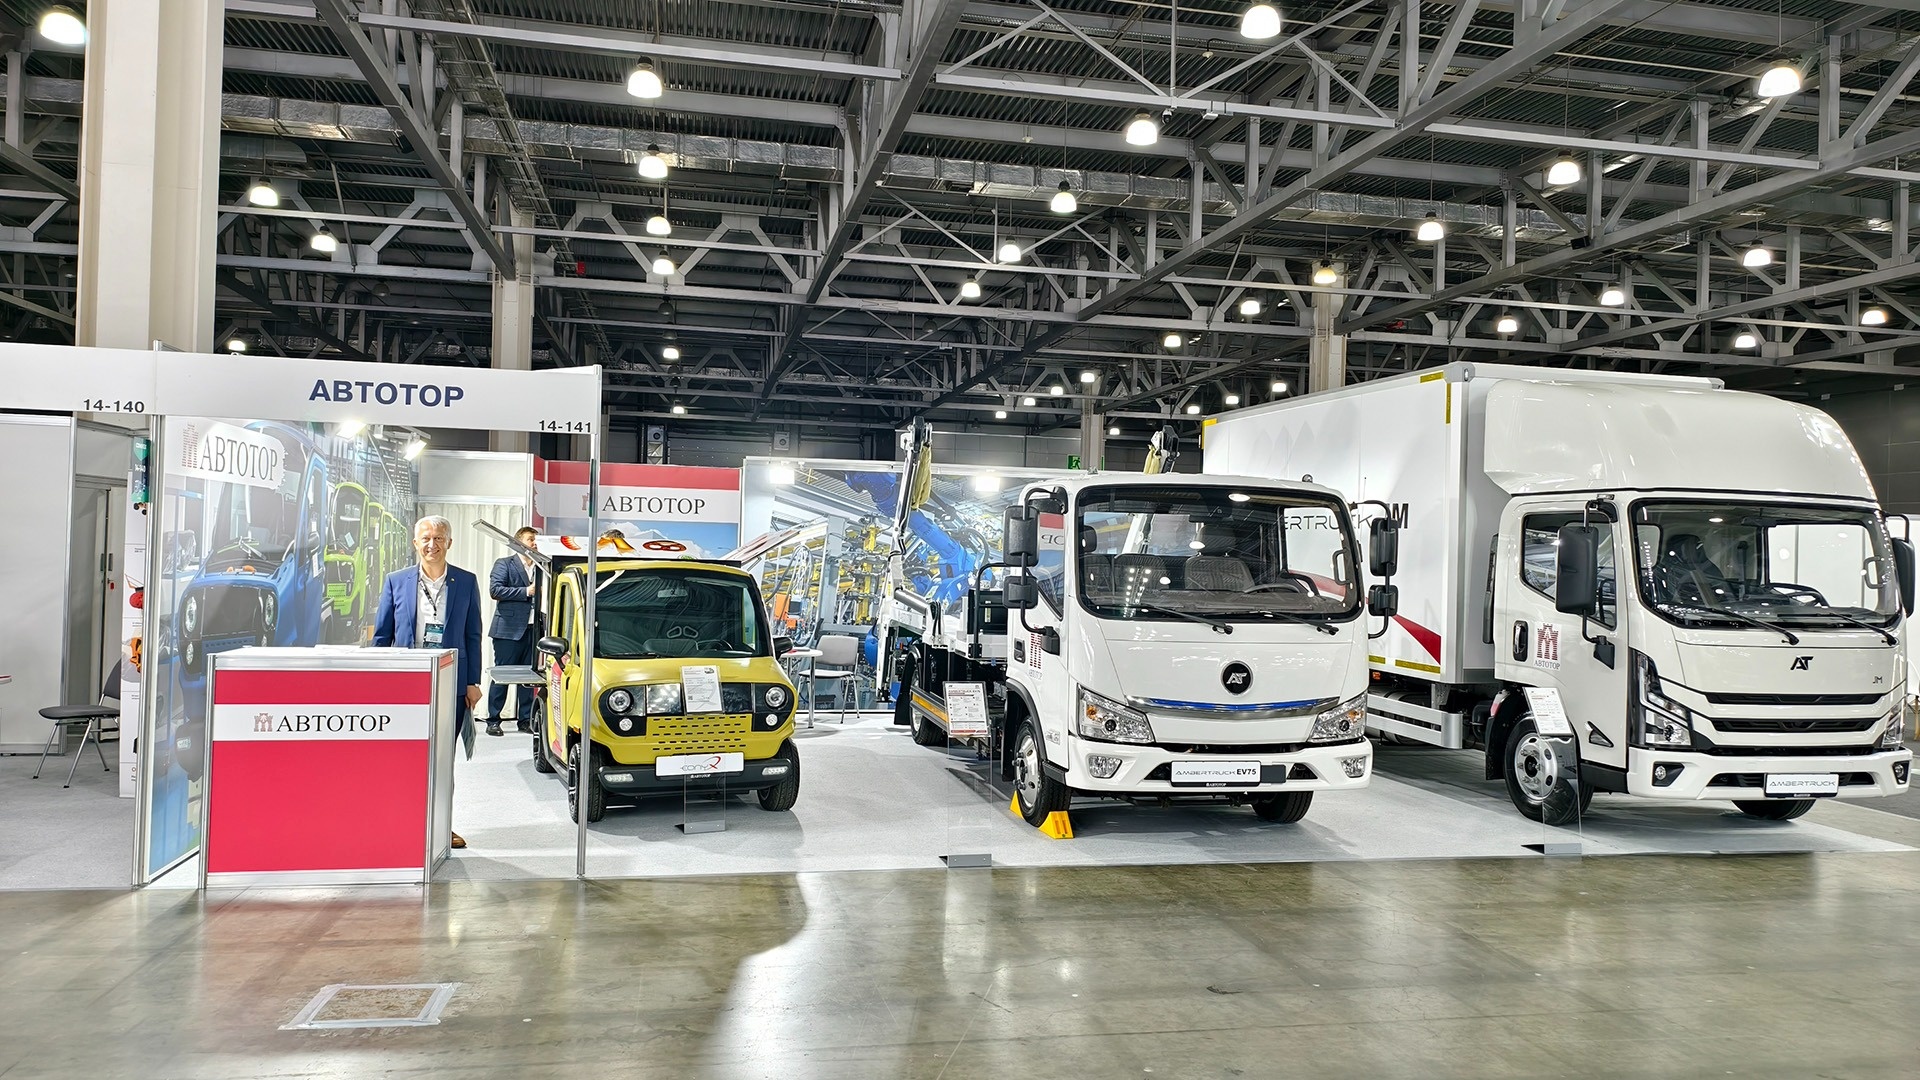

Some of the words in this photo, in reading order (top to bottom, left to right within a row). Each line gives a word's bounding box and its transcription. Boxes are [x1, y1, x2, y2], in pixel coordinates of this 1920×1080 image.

[308, 379, 464, 408] АВТОТОР
[83, 398, 145, 413] 14-140
[539, 420, 591, 433] 14-141
[199, 433, 278, 482] АВТОТОР
[602, 495, 706, 515] АВТОТОР
[276, 714, 391, 733] АВТОТОР
[1236, 768, 1257, 776] EV75
